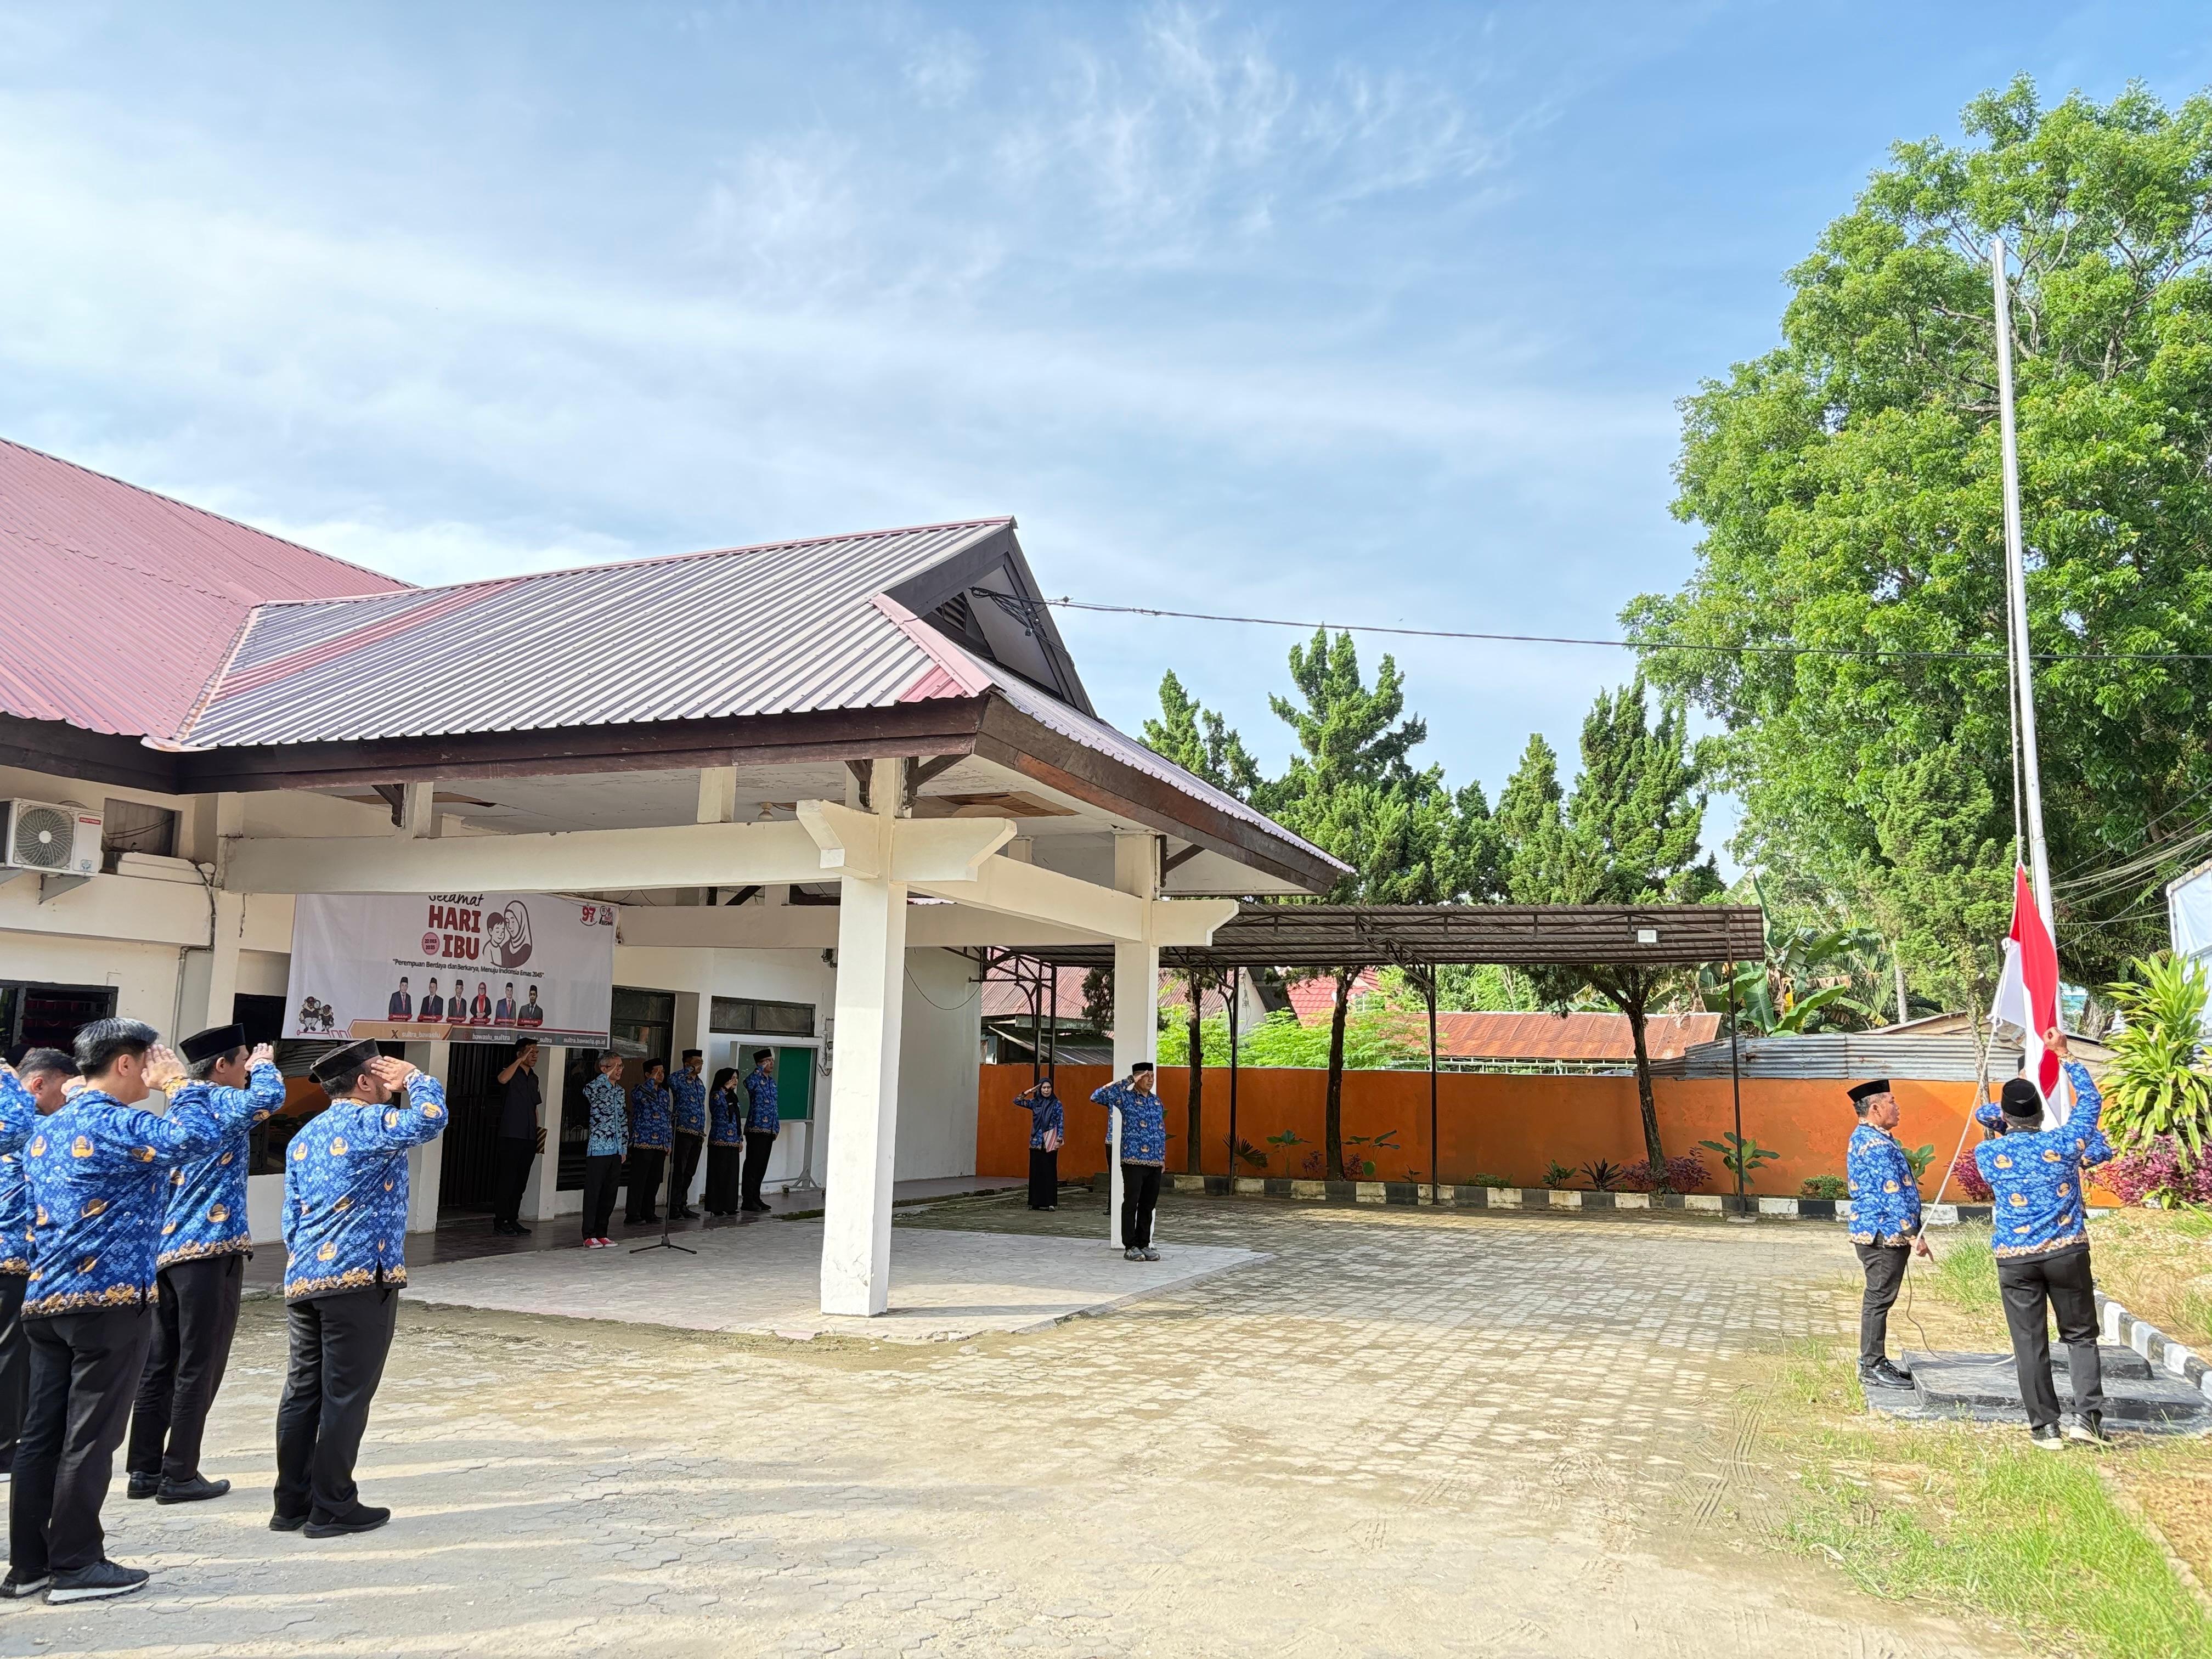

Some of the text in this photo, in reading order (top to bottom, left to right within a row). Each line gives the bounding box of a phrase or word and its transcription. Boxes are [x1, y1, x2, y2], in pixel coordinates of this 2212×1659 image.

[428, 905, 481, 933] HARI
[442, 934, 479, 960] IBU
[426, 962, 447, 970] Berdaya
[458, 964, 479, 973] Berkarya,
[481, 966, 498, 974] Menuju
[472, 1033, 511, 1041] bawaslu_sultra
